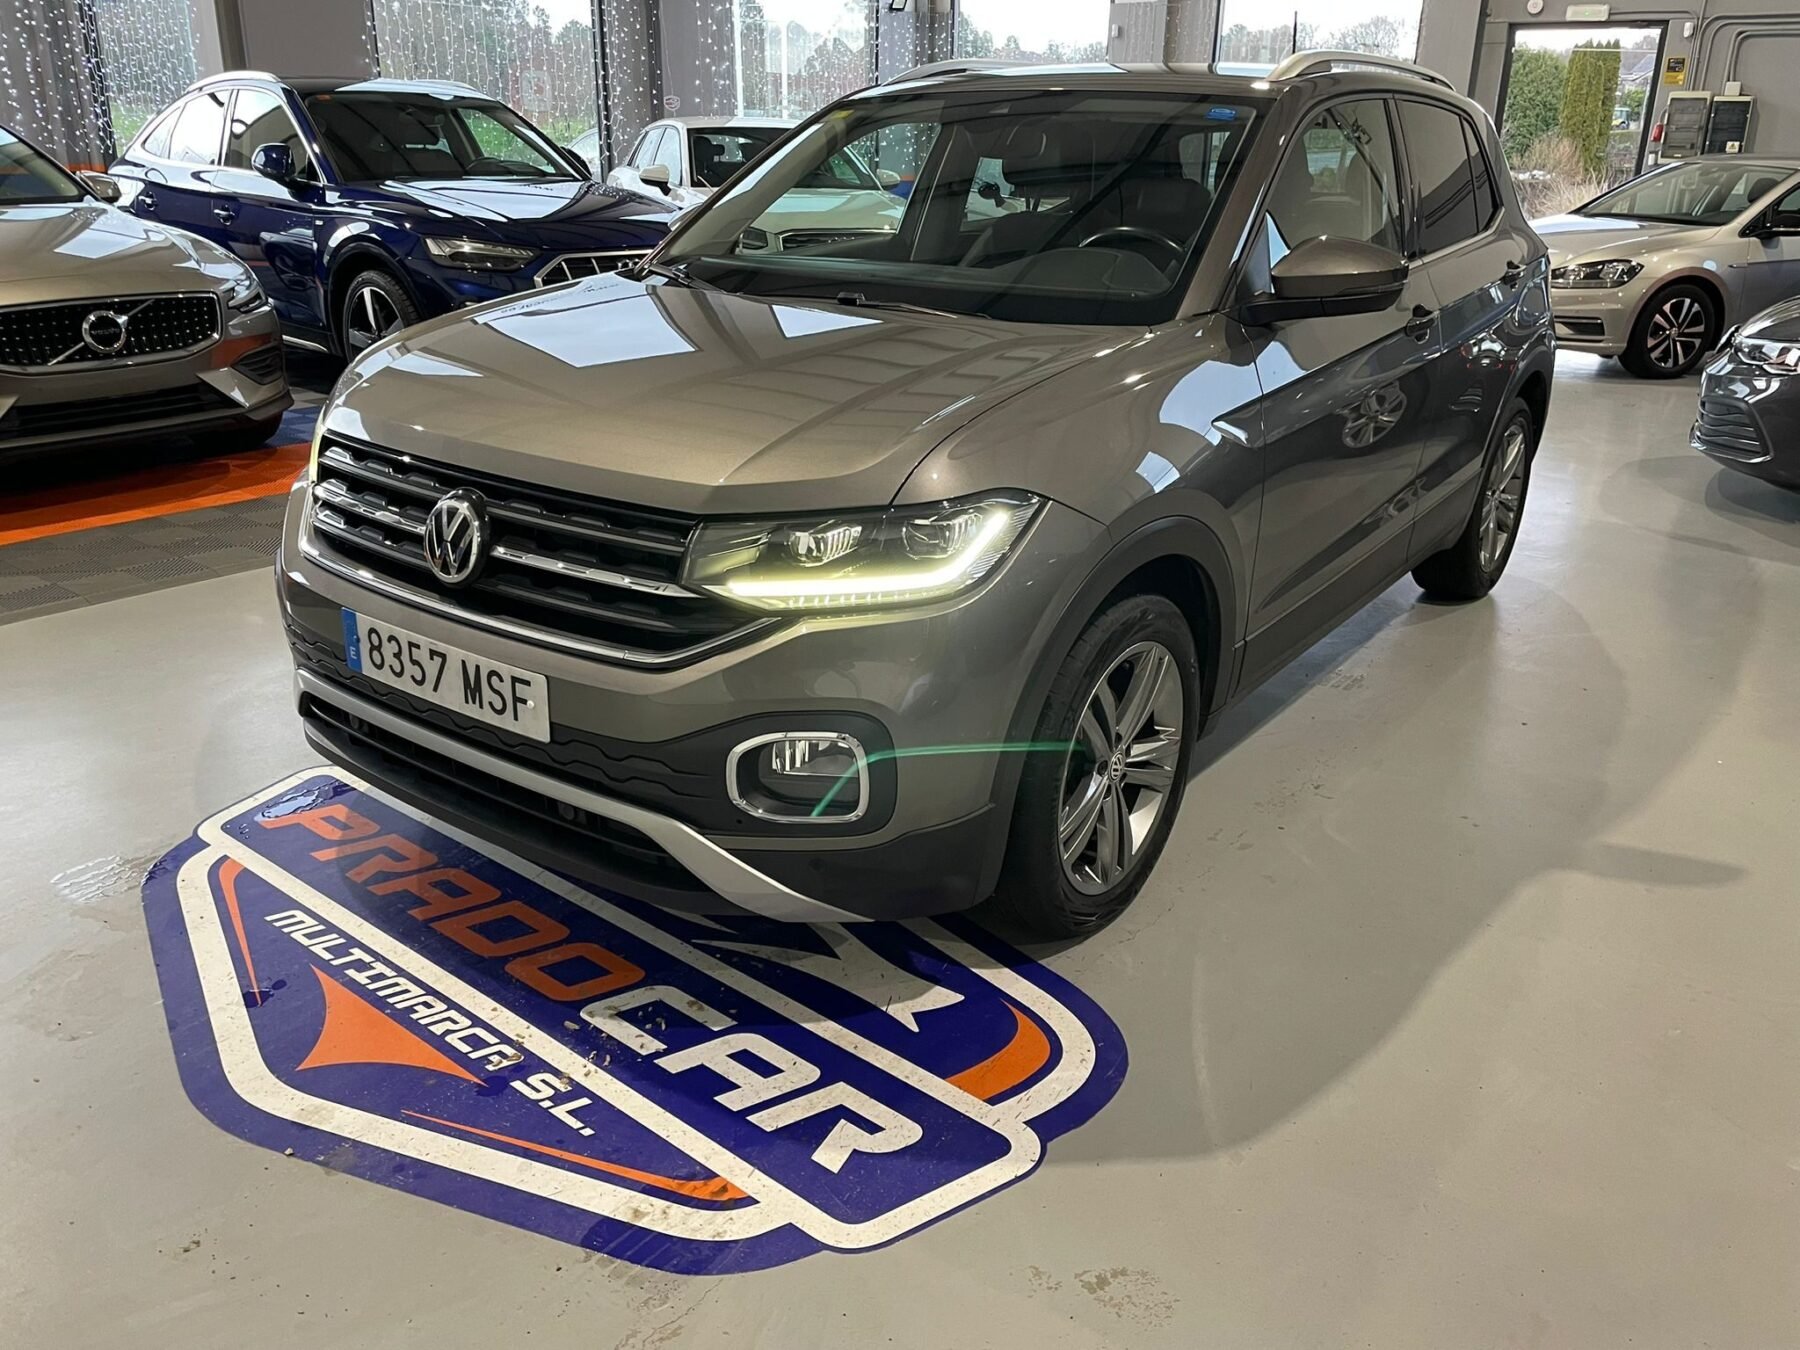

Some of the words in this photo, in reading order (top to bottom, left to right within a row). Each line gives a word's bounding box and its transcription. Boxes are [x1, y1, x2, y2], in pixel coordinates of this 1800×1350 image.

[367, 626, 448, 693] 8357
[461, 658, 532, 722] MSF
[263, 909, 524, 1072] MULTIMARCA
[508, 1072, 596, 1137] S.L.
